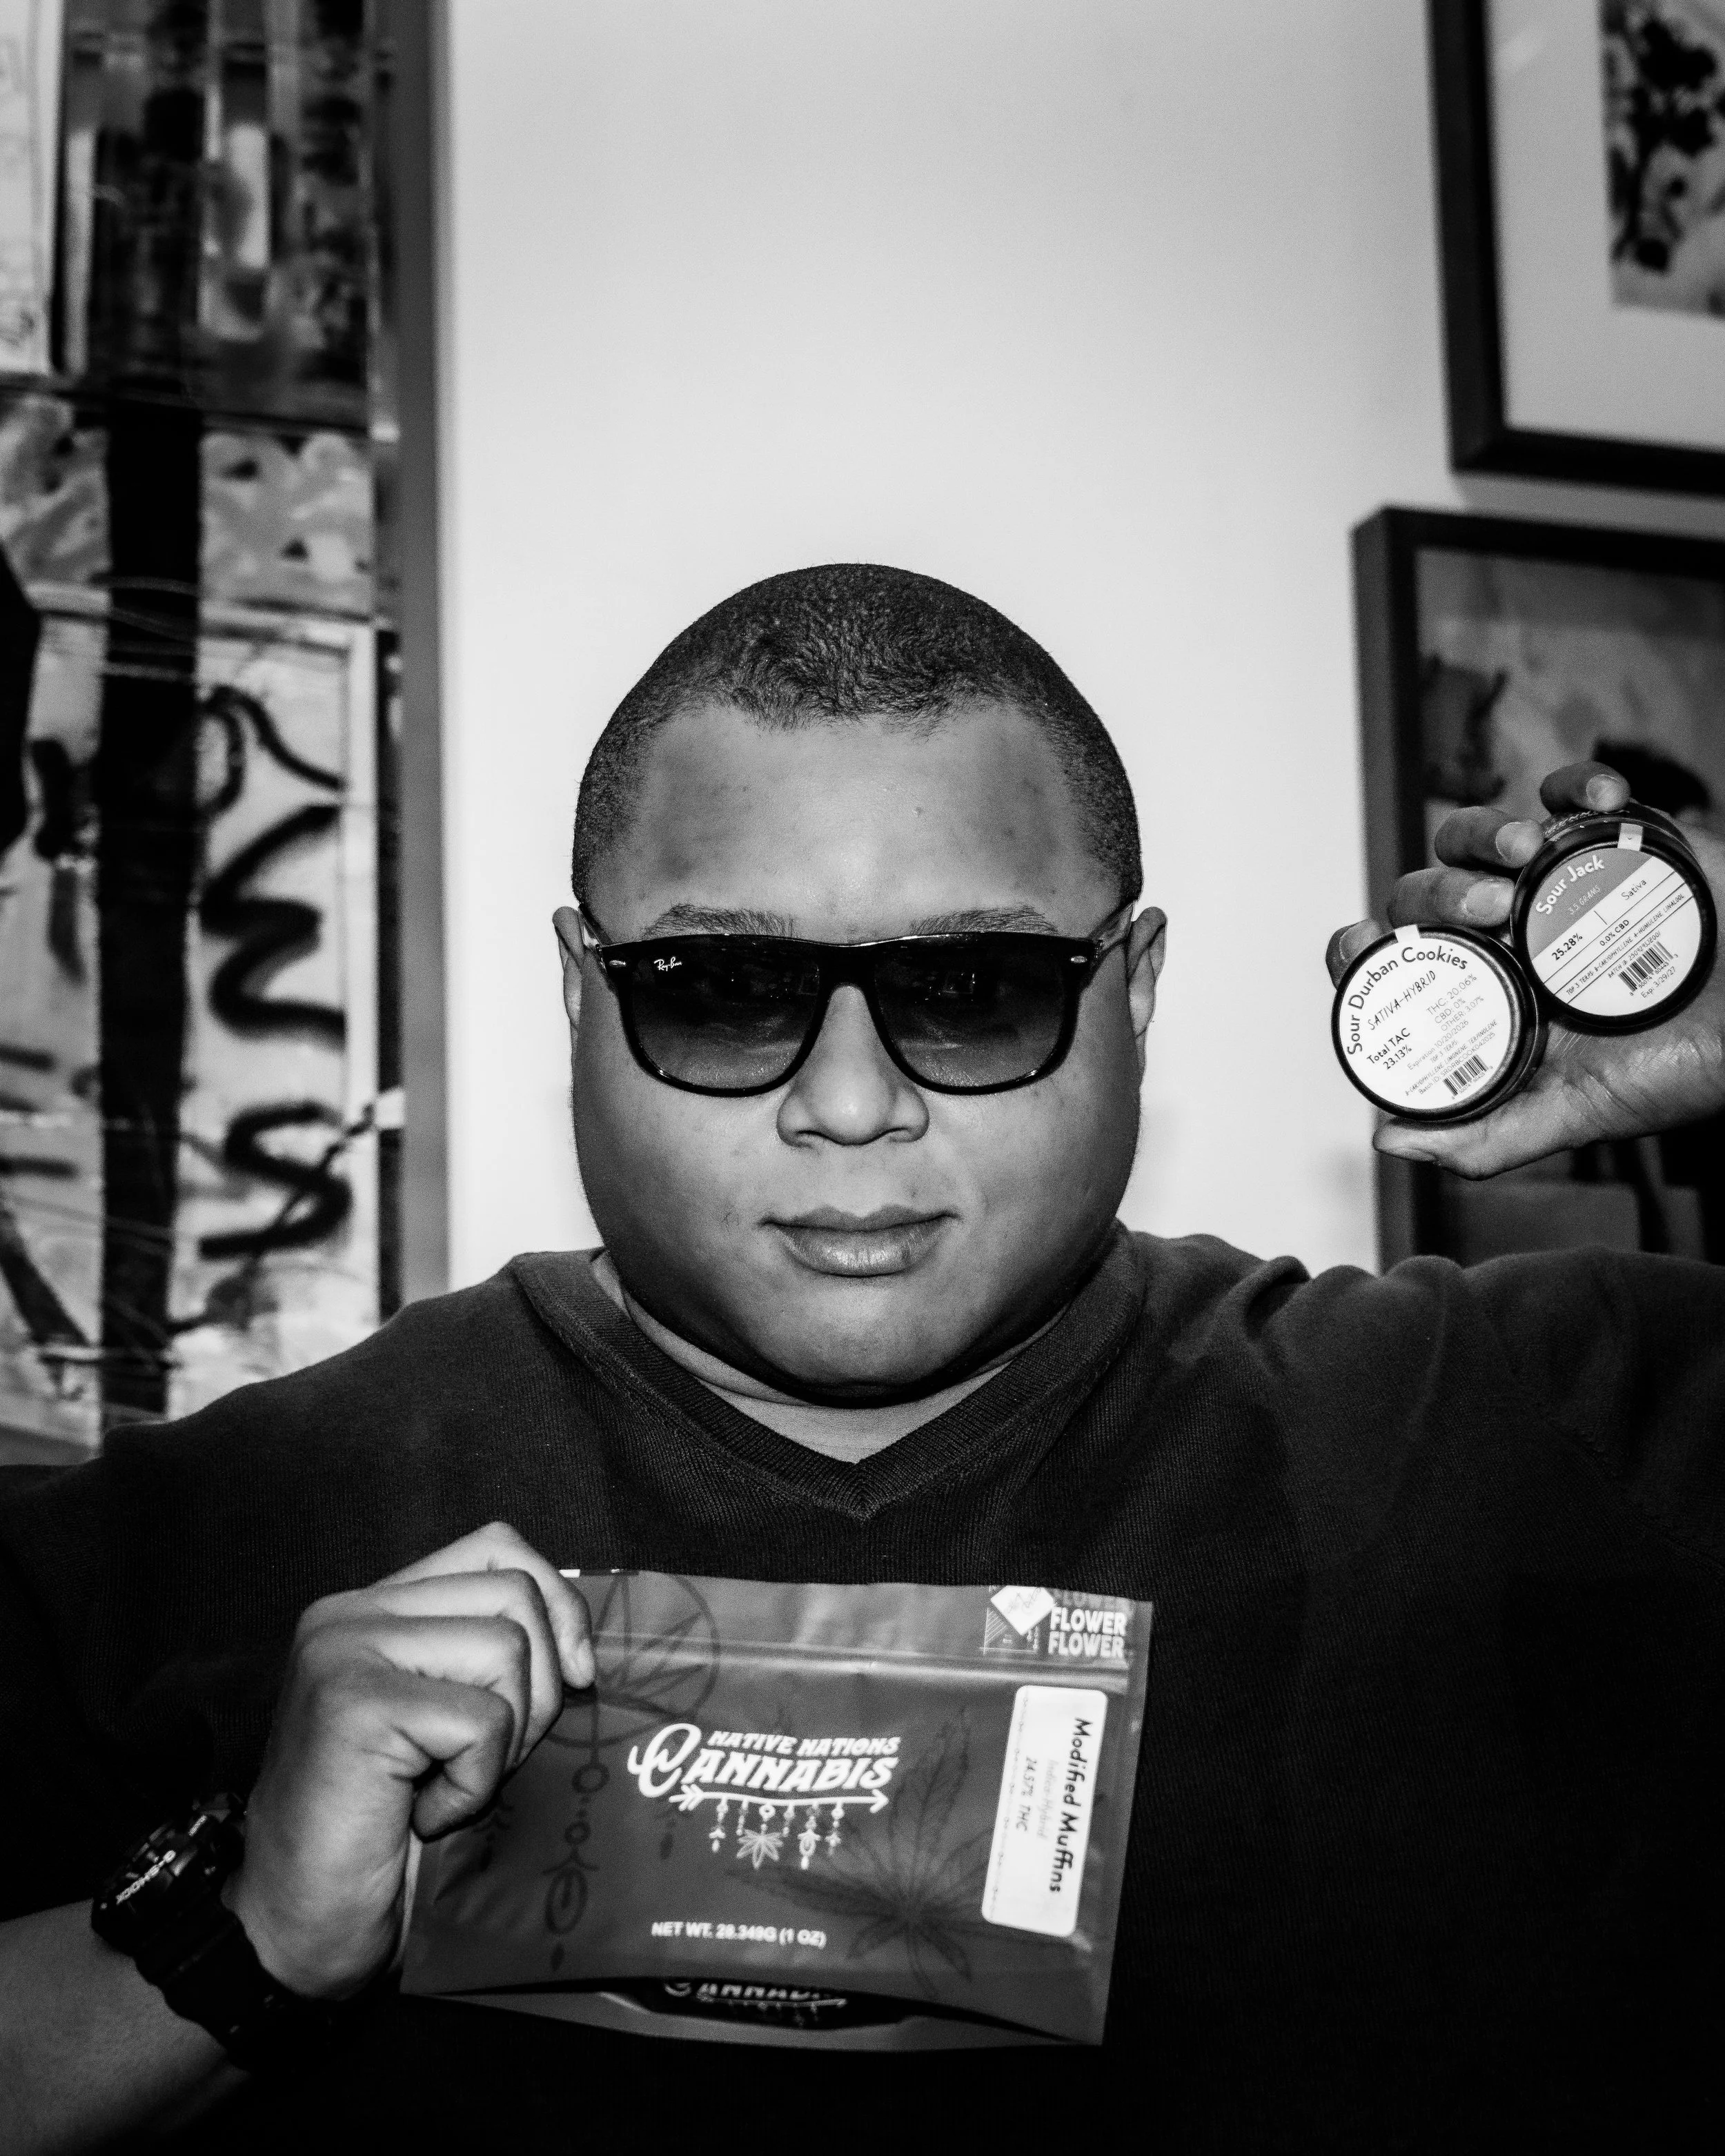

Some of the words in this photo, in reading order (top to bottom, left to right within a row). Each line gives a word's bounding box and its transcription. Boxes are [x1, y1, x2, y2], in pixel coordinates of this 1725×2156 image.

[1535, 878, 1567, 915] Sour
[1567, 854, 1605, 882] Jack
[1579, 884, 1601, 906] GRAMS
[1621, 879, 1647, 900] Sativa
[1551, 933, 1583, 961] 25.28%
[1566, 985, 1575, 996] TOP
[1633, 911, 1664, 939] A-HUMULENE
[1663, 893, 1685, 913] LINALOOL
[1599, 932, 1615, 947] 0.0%
[1614, 919, 1630, 933] CBD
[653, 956, 682, 971] Ray-Ban
[1401, 945, 1468, 970] Cookies
[1608, 965, 1623, 978] BATCH
[1348, 960, 1399, 1010] Durban
[1426, 997, 1448, 1016] THC:
[1447, 973, 1477, 1000] 20.06%
[1641, 987, 1655, 998] Exp:
[1653, 966, 1675, 987] 3/29/27
[1368, 970, 1436, 1030] SATIVA-HYBRID
[1435, 1007, 1454, 1024] CBD:
[1453, 998, 1466, 1009] 0%
[1441, 1011, 1466, 1031] OTHER:
[1465, 996, 1483, 1012] 3.07%
[1347, 1015, 1363, 1055] Sour
[1366, 1044, 1390, 1064] Total
[1388, 1027, 1410, 1047] TAC
[1407, 1047, 1435, 1070] Expiration
[1434, 1020, 1468, 1048] 10/20/2026
[1445, 1044, 1468, 1065] LIMONENE
[1467, 1019, 1498, 1045] TERPINOLENE
[1383, 1045, 1412, 1070] 23.13%
[1419, 1082, 1433, 1095] Batch
[1050, 1606, 1127, 1636] FLOWER
[1048, 1630, 1125, 1657] FLOWER
[707, 1730, 799, 1754] NATIVE
[796, 1737, 901, 1757] NATIONS
[627, 1722, 898, 1798] CANNABIS
[1063, 1717, 1094, 1810] Modified
[1016, 1804, 1031, 1832] THC
[1049, 1810, 1081, 1894] Muffins
[651, 1921, 684, 1937] NET
[797, 1929, 827, 1950] OZ)
